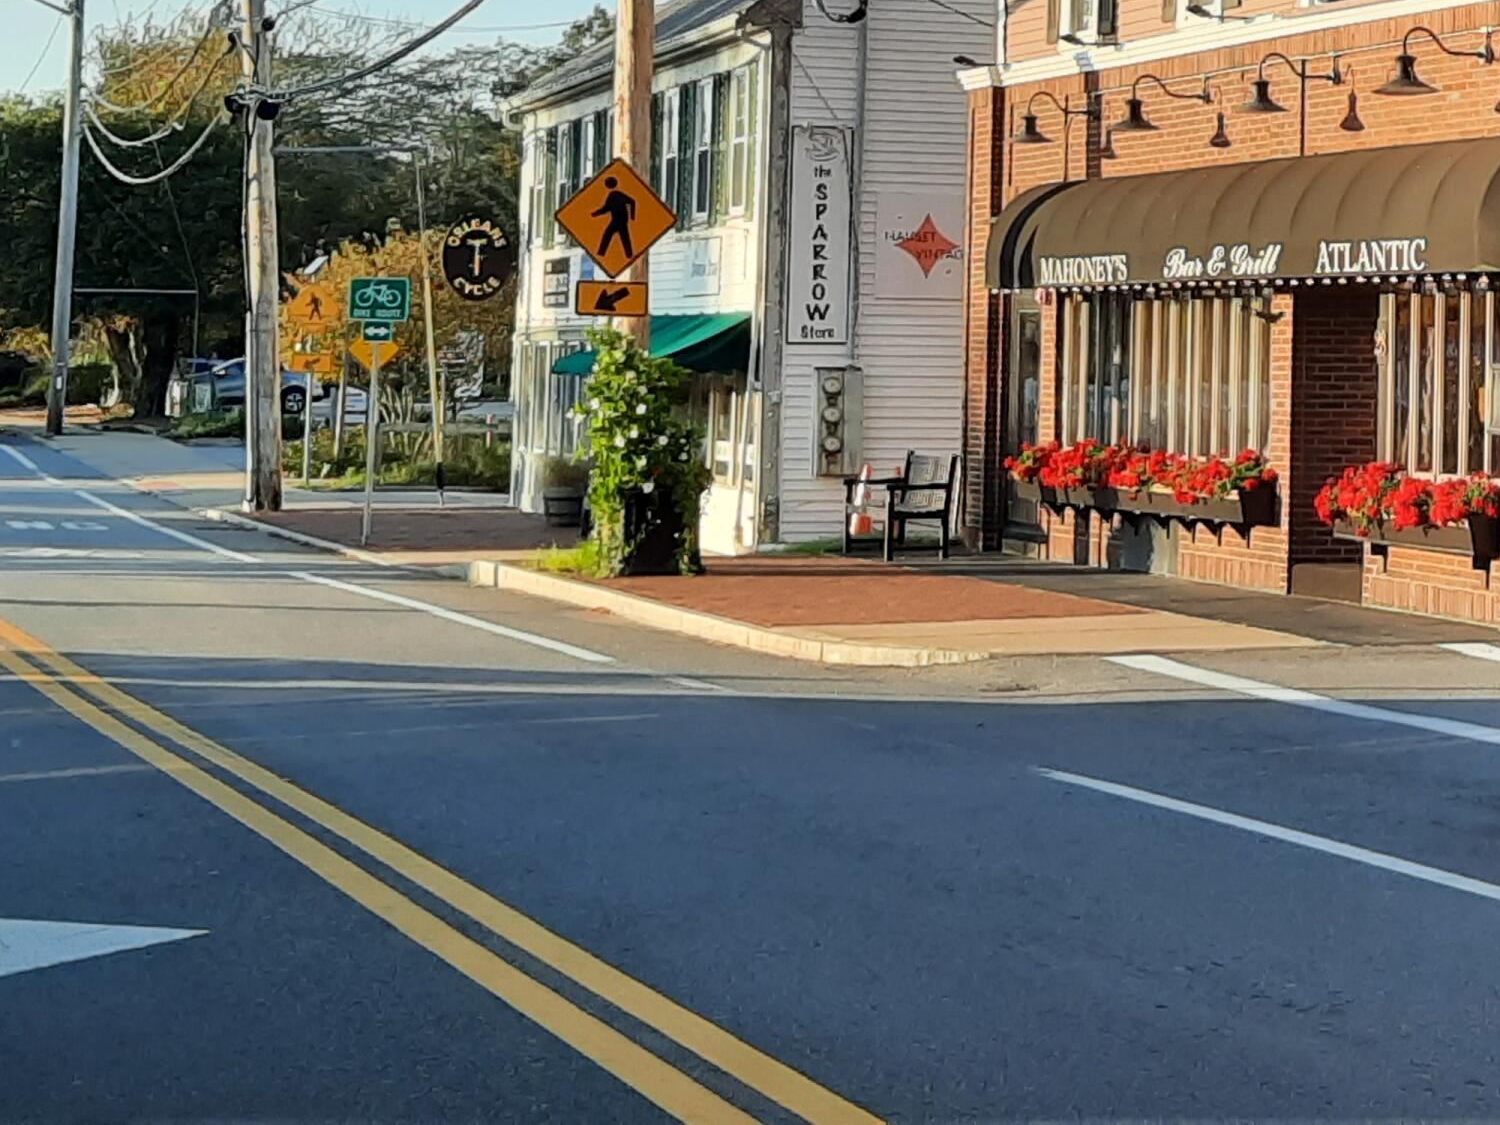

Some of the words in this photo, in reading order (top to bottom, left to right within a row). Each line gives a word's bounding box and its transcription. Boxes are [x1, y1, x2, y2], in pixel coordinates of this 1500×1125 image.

[805, 182, 831, 322] SPARROW
[1039, 254, 1128, 284] MAHONEY'S
[1163, 248, 1204, 278] Bar
[1207, 245, 1226, 275] &
[1230, 244, 1282, 276] Grill
[1314, 238, 1428, 274] ATLANTIC
[453, 276, 501, 295] CYCLE
[800, 324, 835, 339] Store
